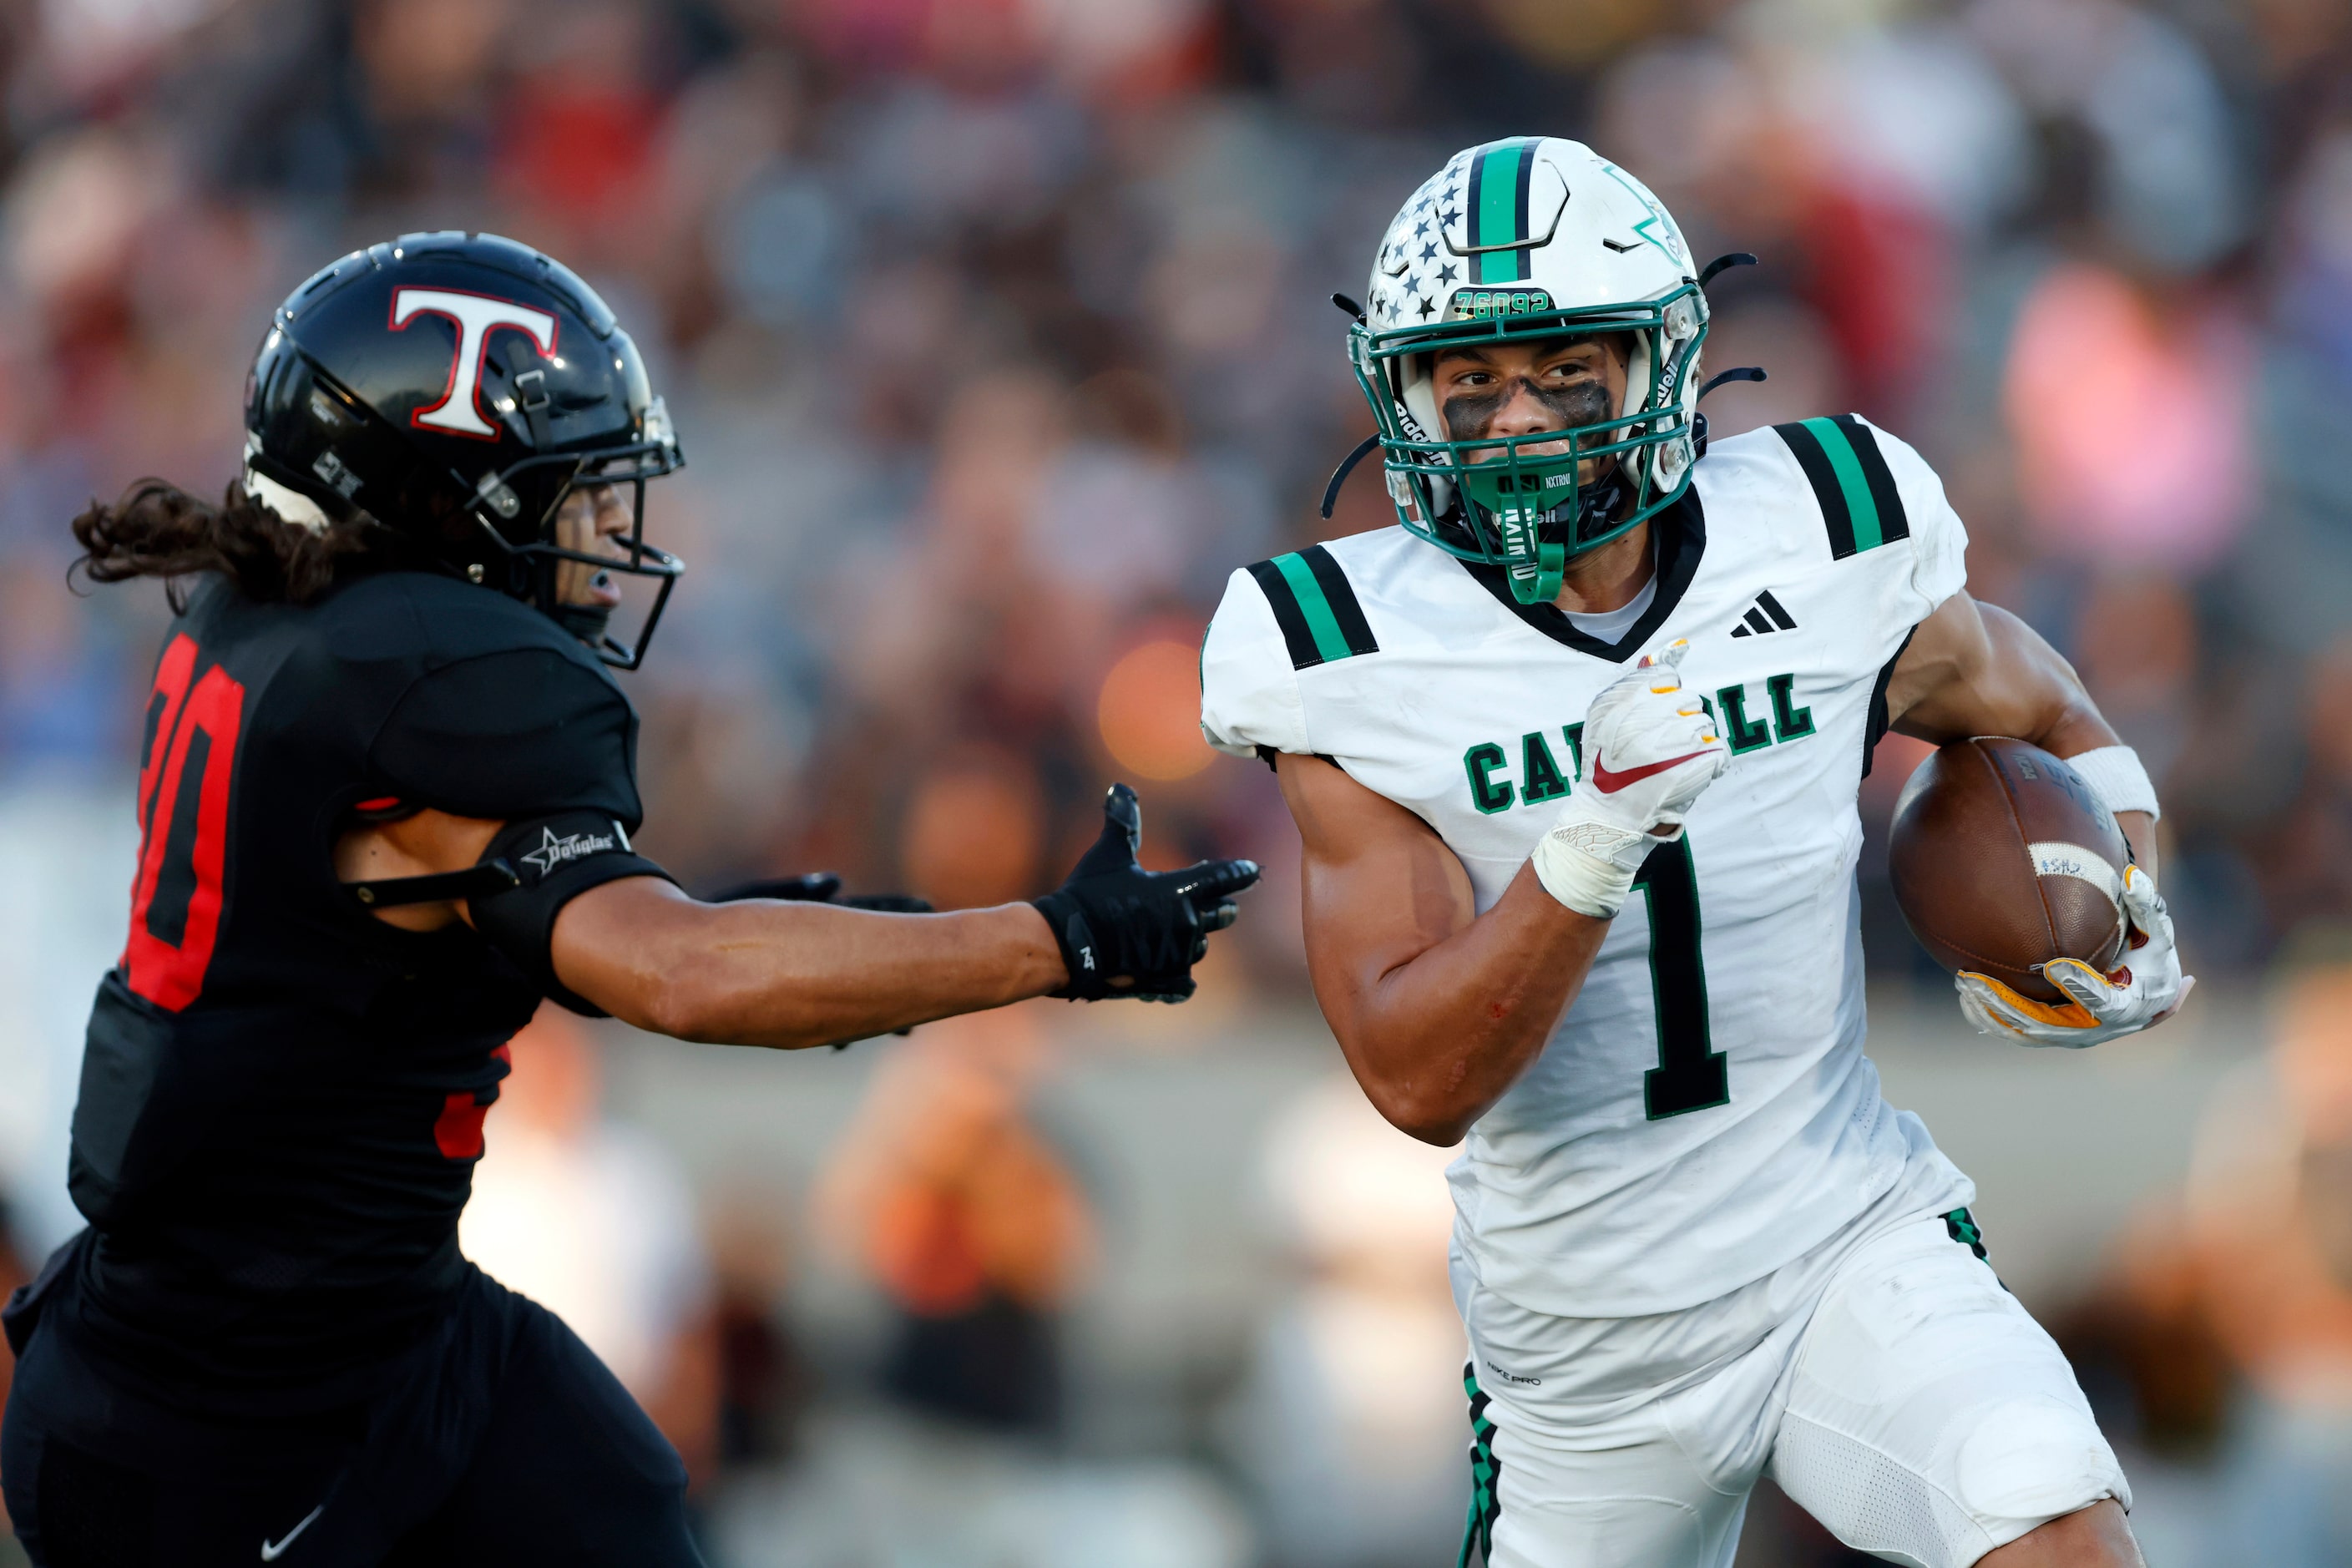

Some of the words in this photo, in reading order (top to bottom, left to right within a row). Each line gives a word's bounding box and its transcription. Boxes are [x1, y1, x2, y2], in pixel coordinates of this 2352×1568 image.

[1455, 291, 1549, 321] 76092
[388, 285, 560, 443] T
[1463, 673, 1817, 815] CALL
[548, 834, 605, 862] Douglas
[1629, 822, 1731, 1121] 1
[1487, 1361, 1510, 1380] NIKE
[1511, 1376, 1541, 1386] PRO
